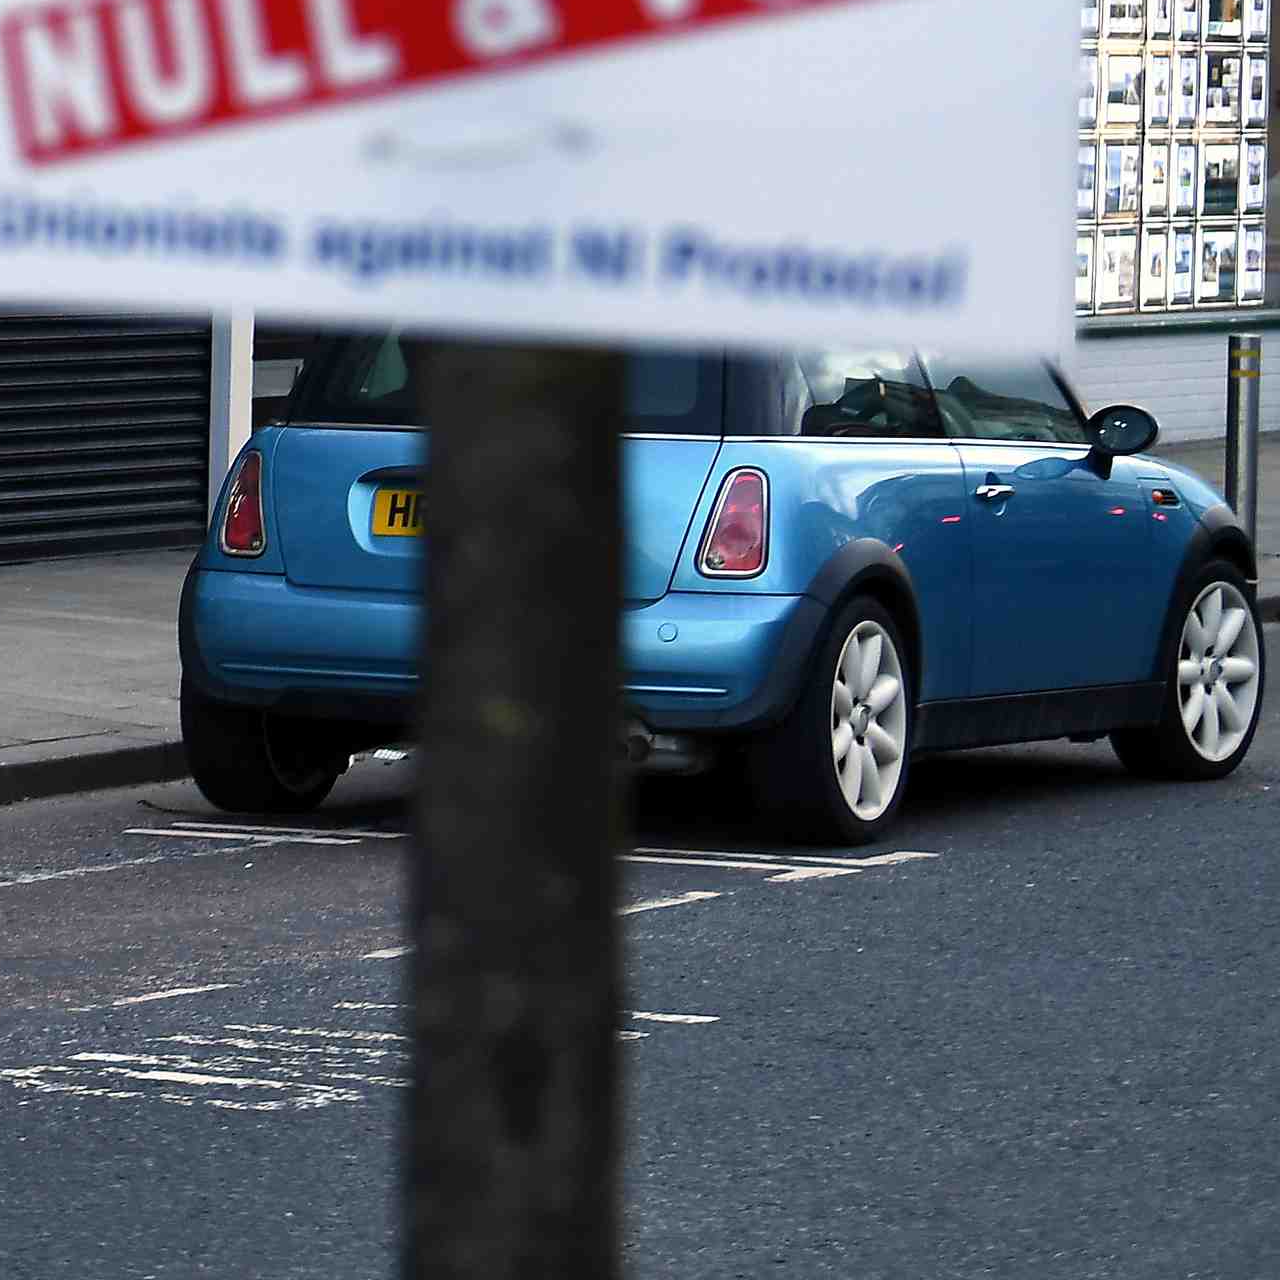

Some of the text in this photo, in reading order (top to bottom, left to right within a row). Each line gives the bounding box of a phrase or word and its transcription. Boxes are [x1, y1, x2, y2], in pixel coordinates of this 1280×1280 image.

[312, 206, 551, 286] against
[570, 220, 633, 283] NI
[656, 220, 968, 312] Protocol
